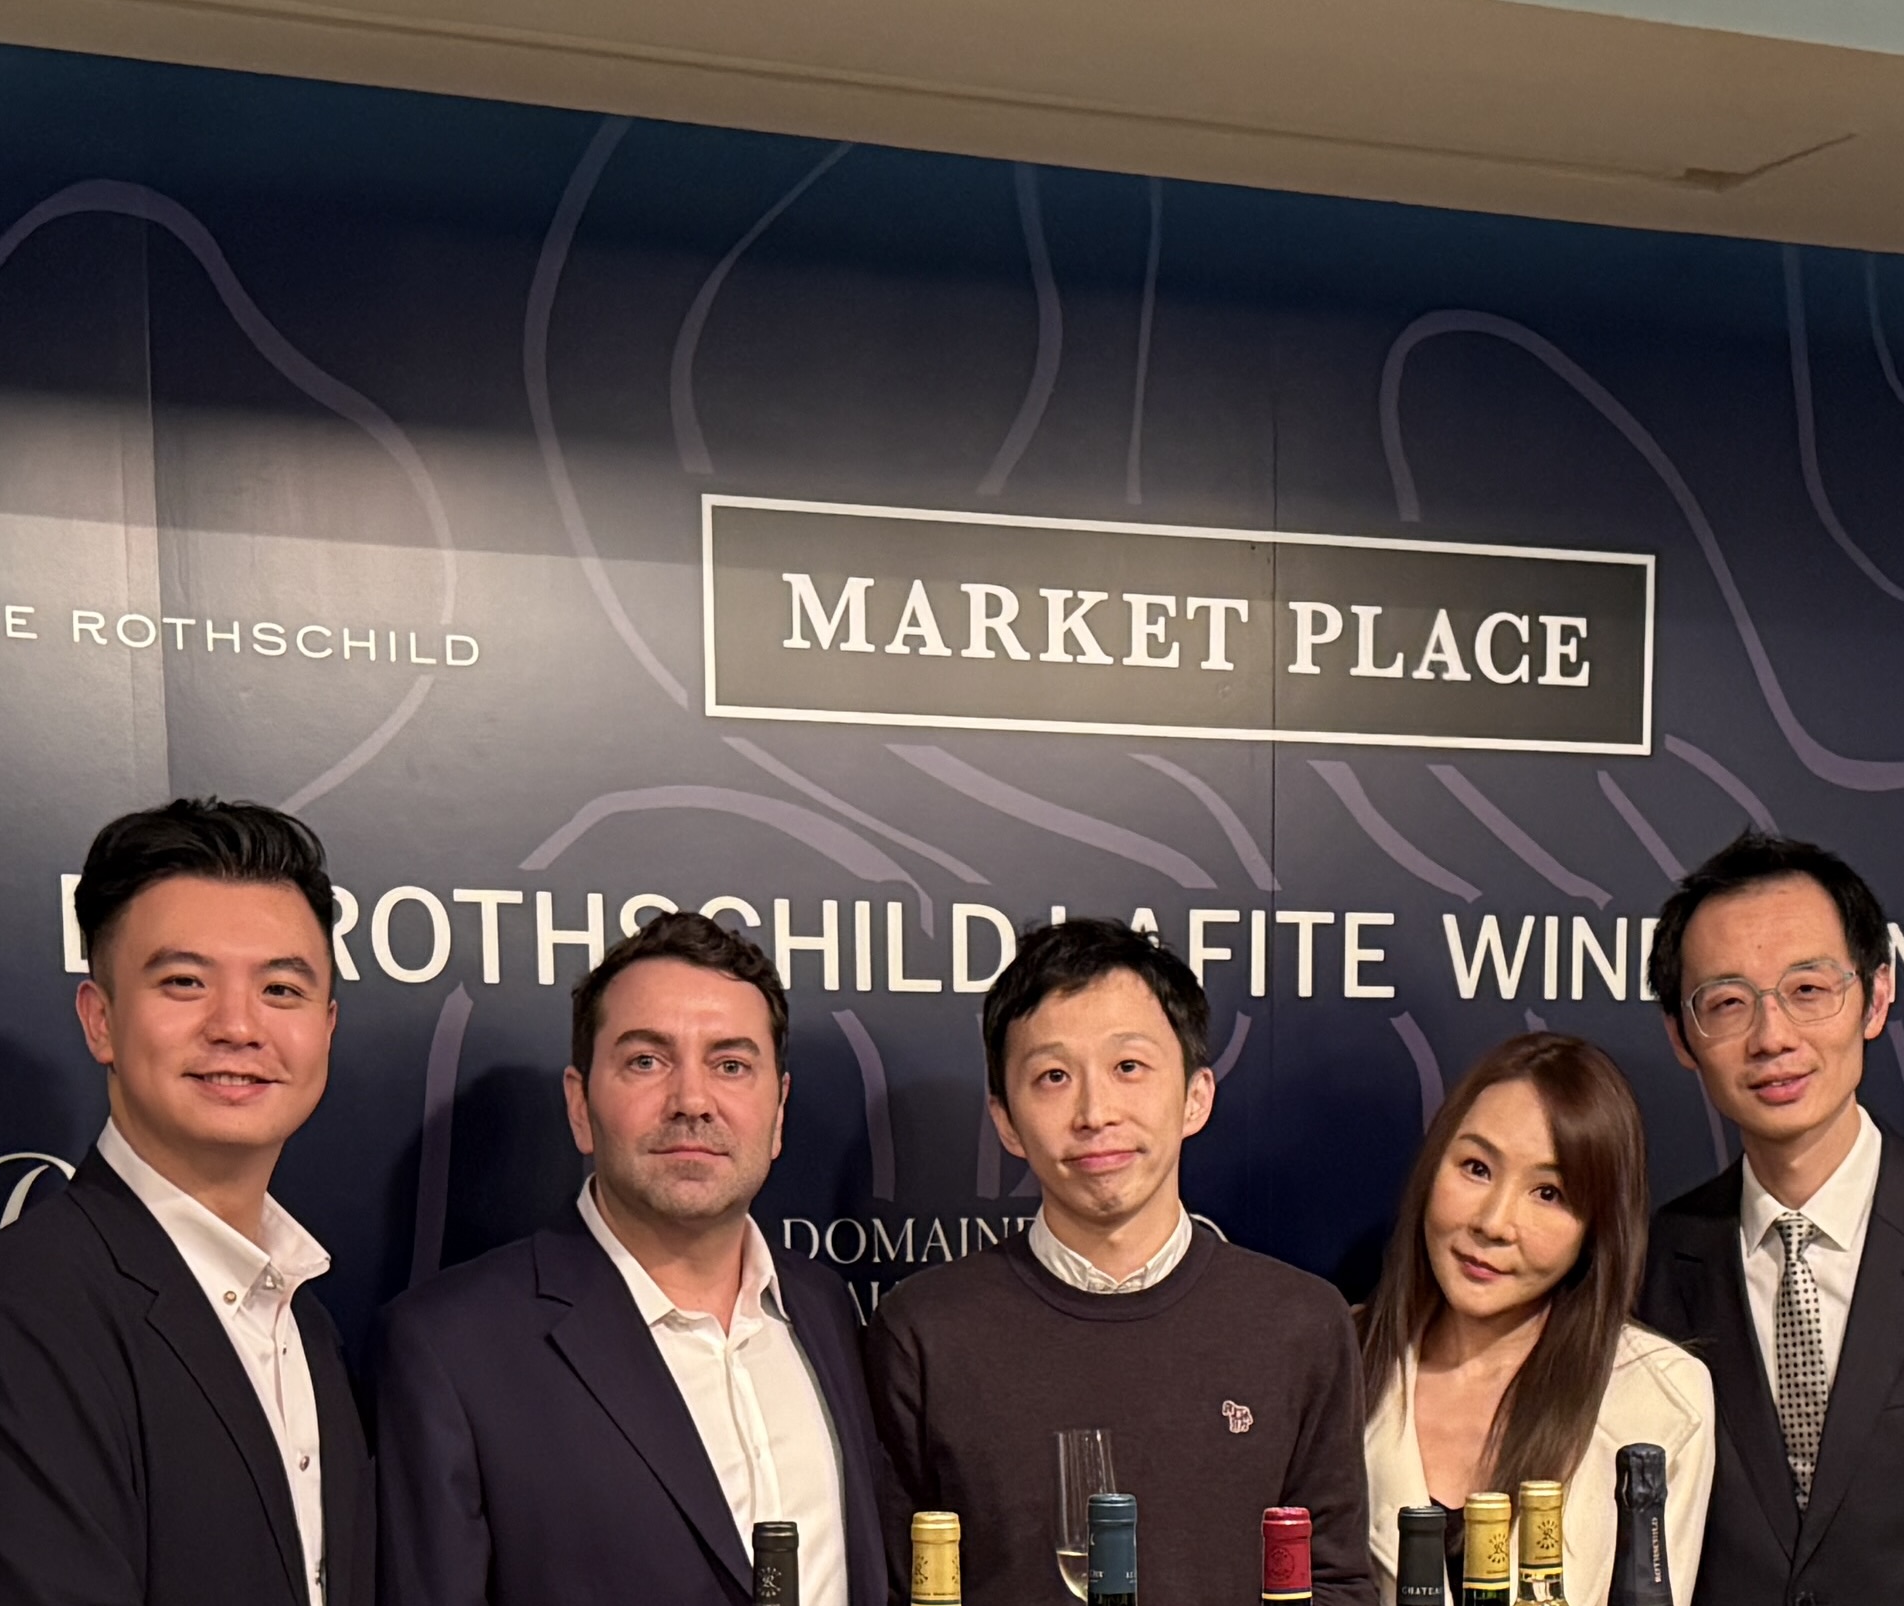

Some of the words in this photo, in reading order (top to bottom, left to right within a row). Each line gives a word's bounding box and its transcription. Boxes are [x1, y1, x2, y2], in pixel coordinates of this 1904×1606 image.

[72, 609, 480, 667] ROTHSCHILD
[782, 573, 1249, 672] MARKET
[1287, 601, 1591, 688] PLACE
